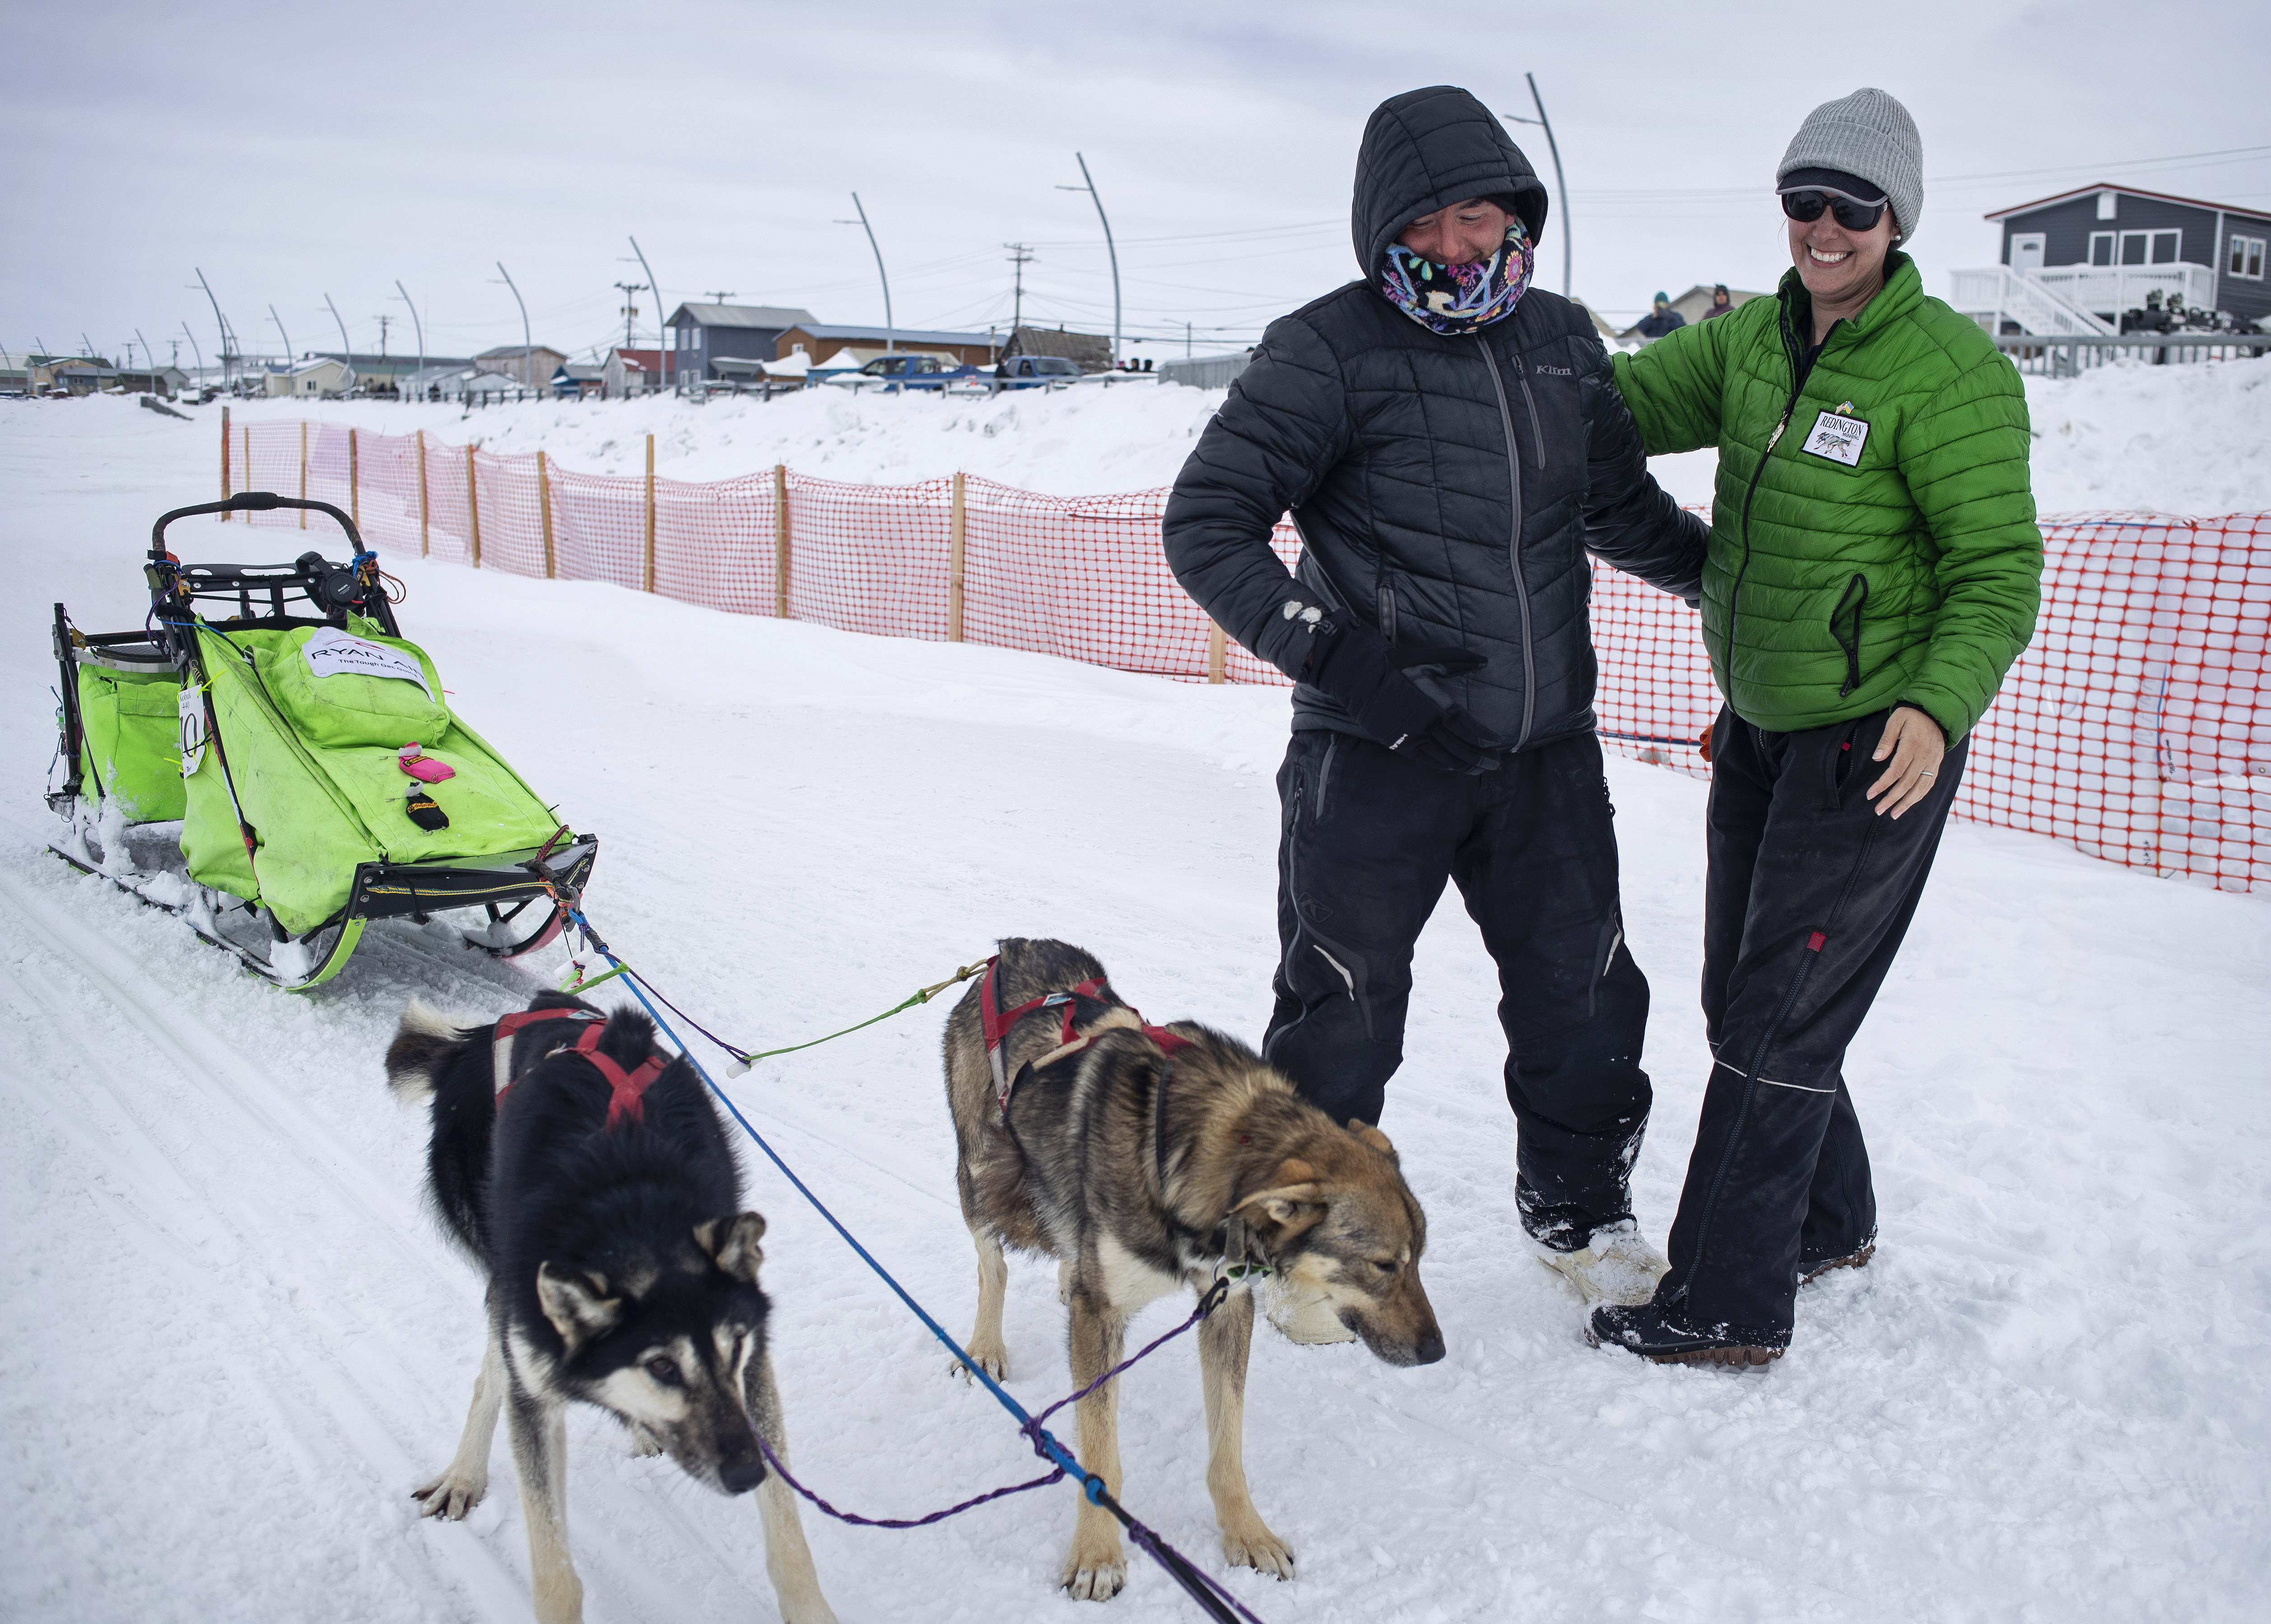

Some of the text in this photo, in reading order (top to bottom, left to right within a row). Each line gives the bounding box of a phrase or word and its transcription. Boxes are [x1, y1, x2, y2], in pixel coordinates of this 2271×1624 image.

[1536, 365, 1572, 376] Klim
[1820, 416, 1864, 436] REDINGTON
[1842, 432, 1859, 440] MUSHING
[312, 648, 427, 683] RYAN AIR
[179, 691, 191, 702] Kobuk
